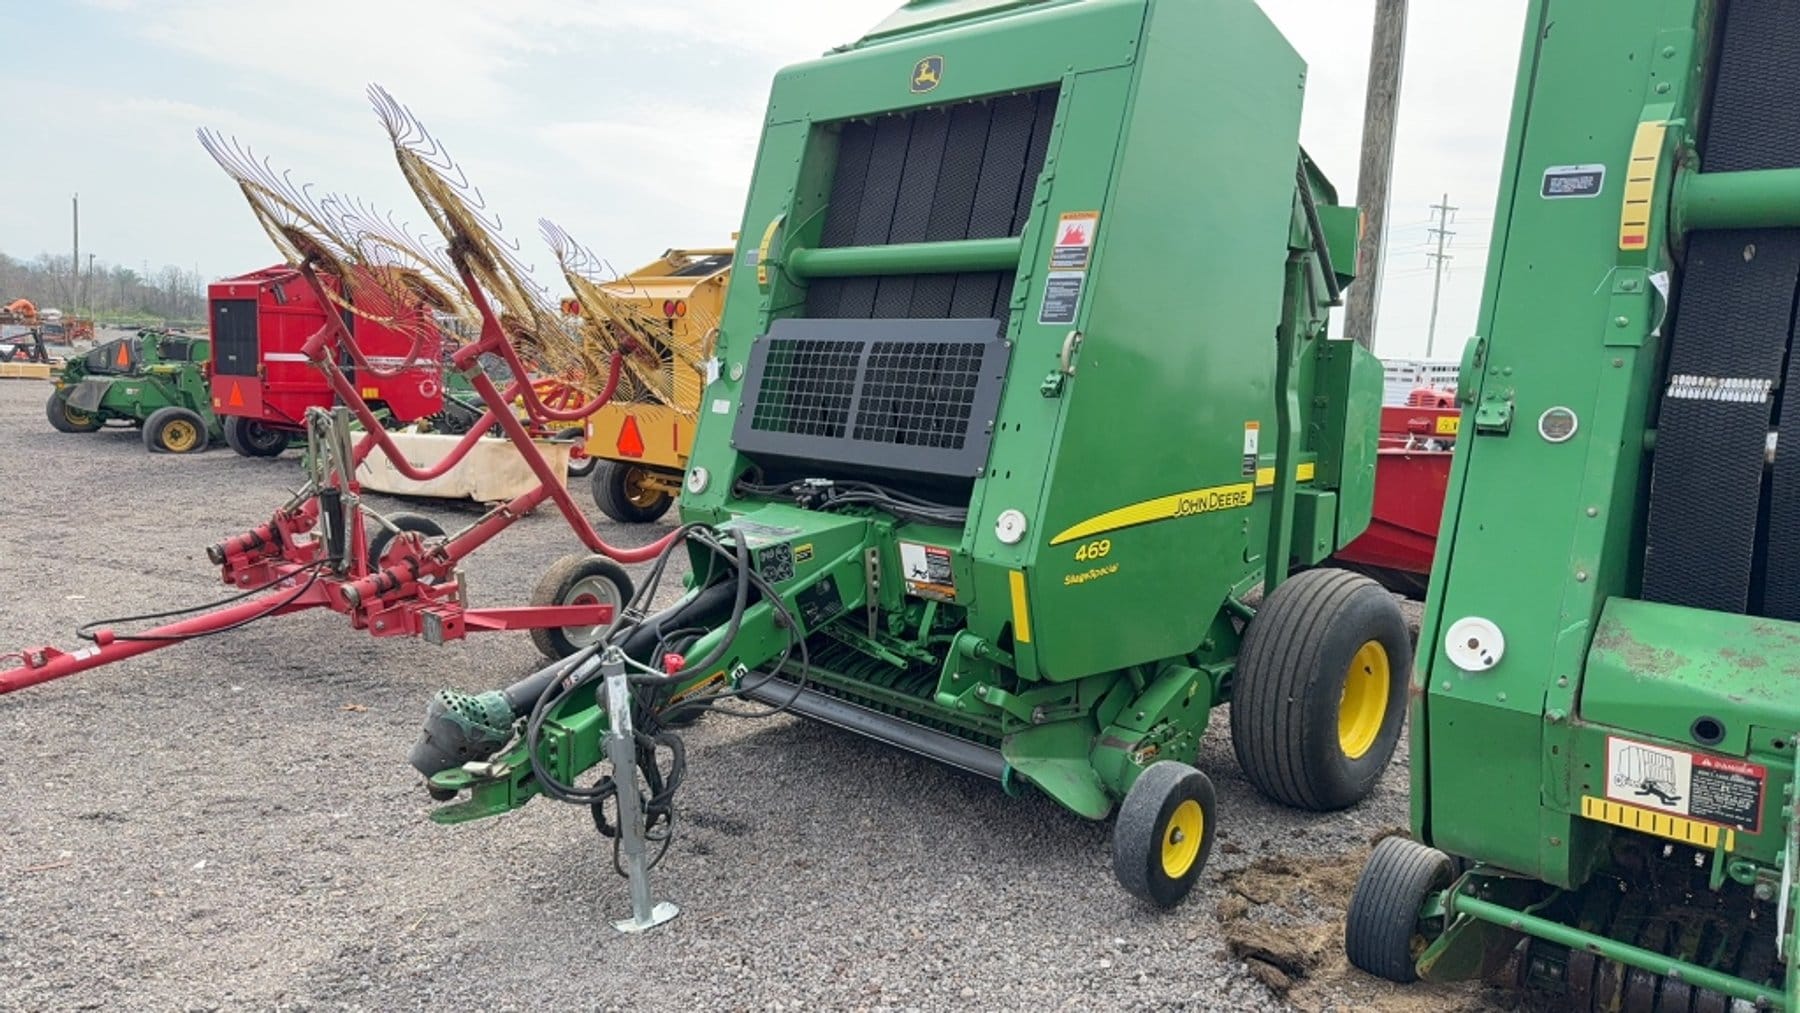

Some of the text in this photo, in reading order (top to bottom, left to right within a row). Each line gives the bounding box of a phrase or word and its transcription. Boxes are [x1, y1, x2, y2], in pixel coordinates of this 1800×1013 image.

[1175, 491, 1248, 515] JOHN DEERE
[1075, 540, 1110, 562] 469
